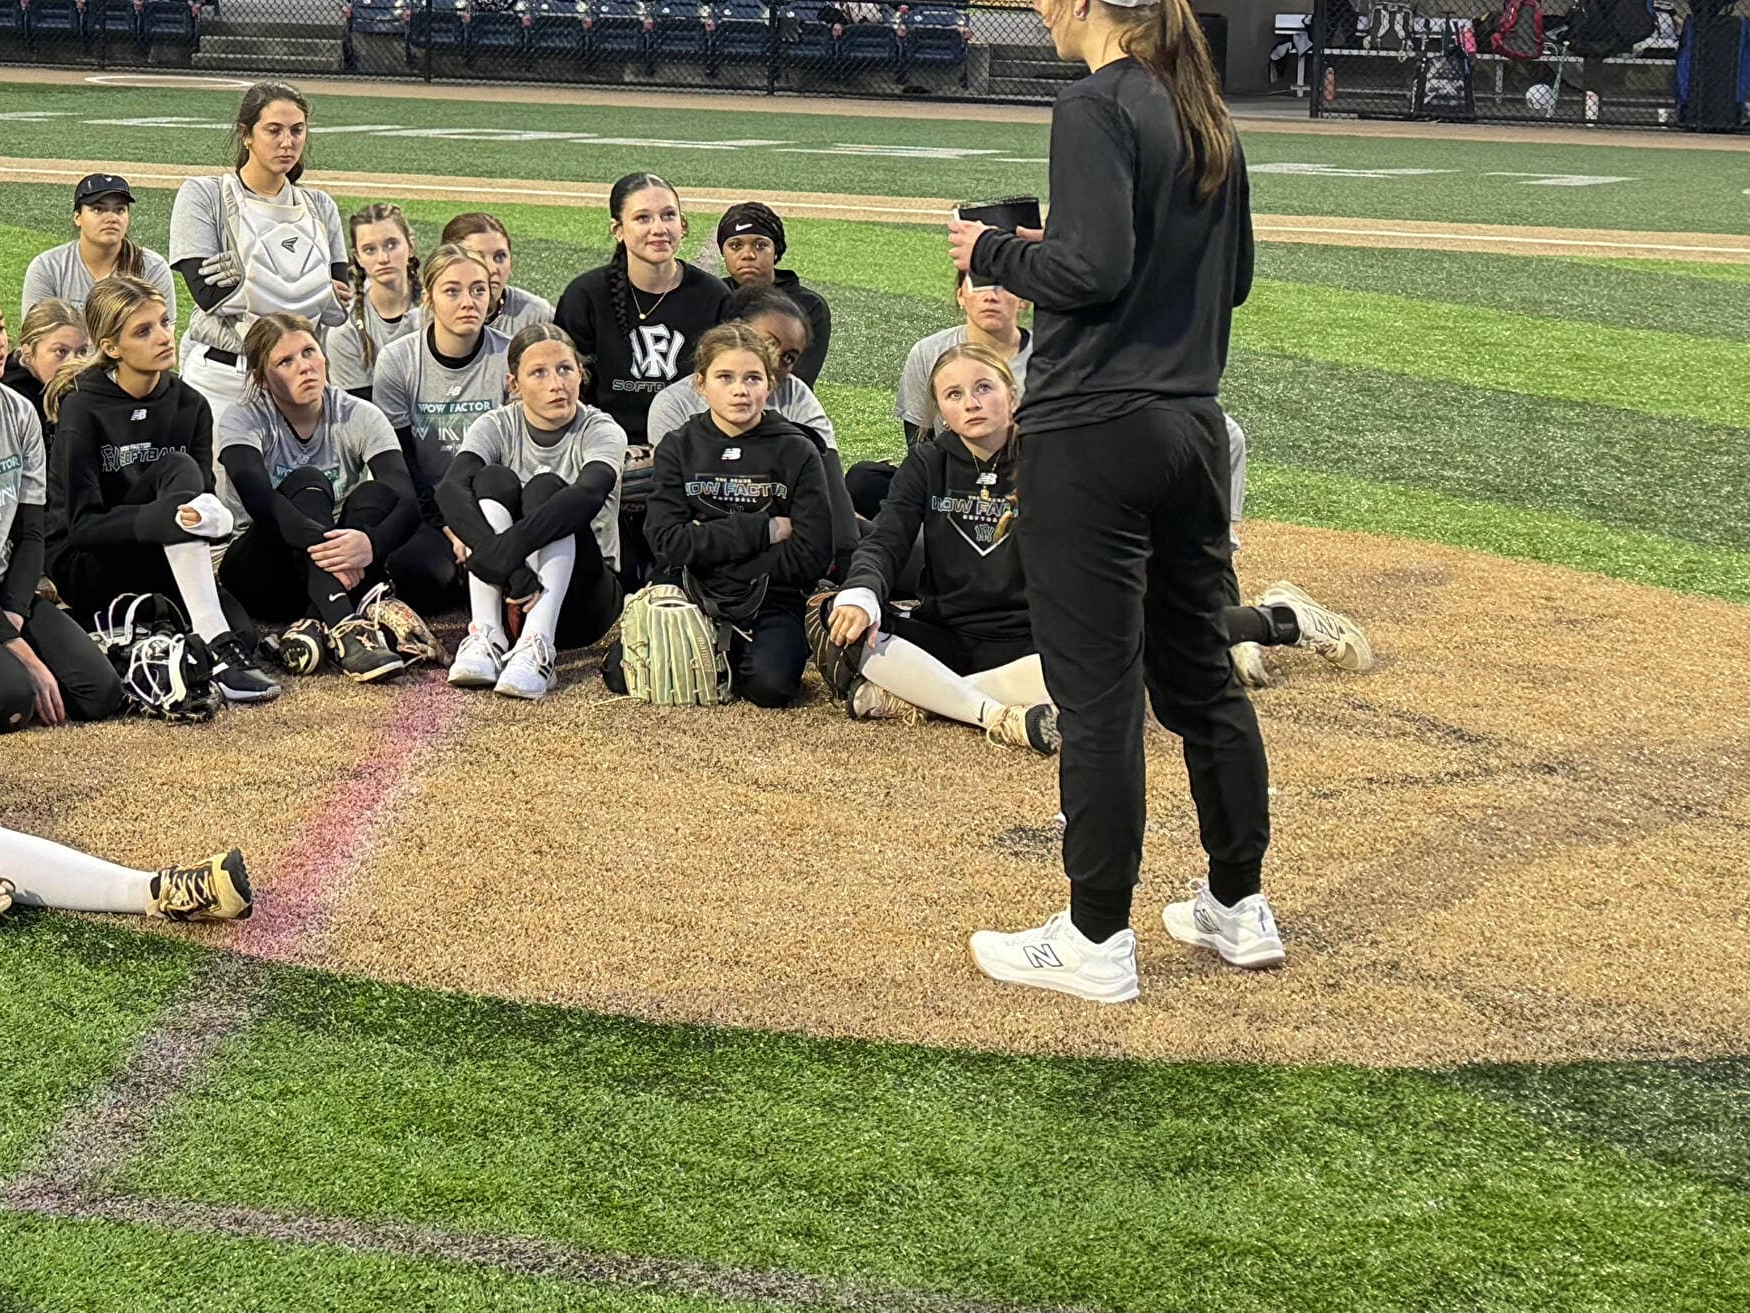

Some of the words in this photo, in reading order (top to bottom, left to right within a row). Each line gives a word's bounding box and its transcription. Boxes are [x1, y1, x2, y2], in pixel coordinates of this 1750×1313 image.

[612, 379, 666, 393] SOFTB
[417, 403, 447, 414] WOW
[449, 401, 491, 413] FACTOR
